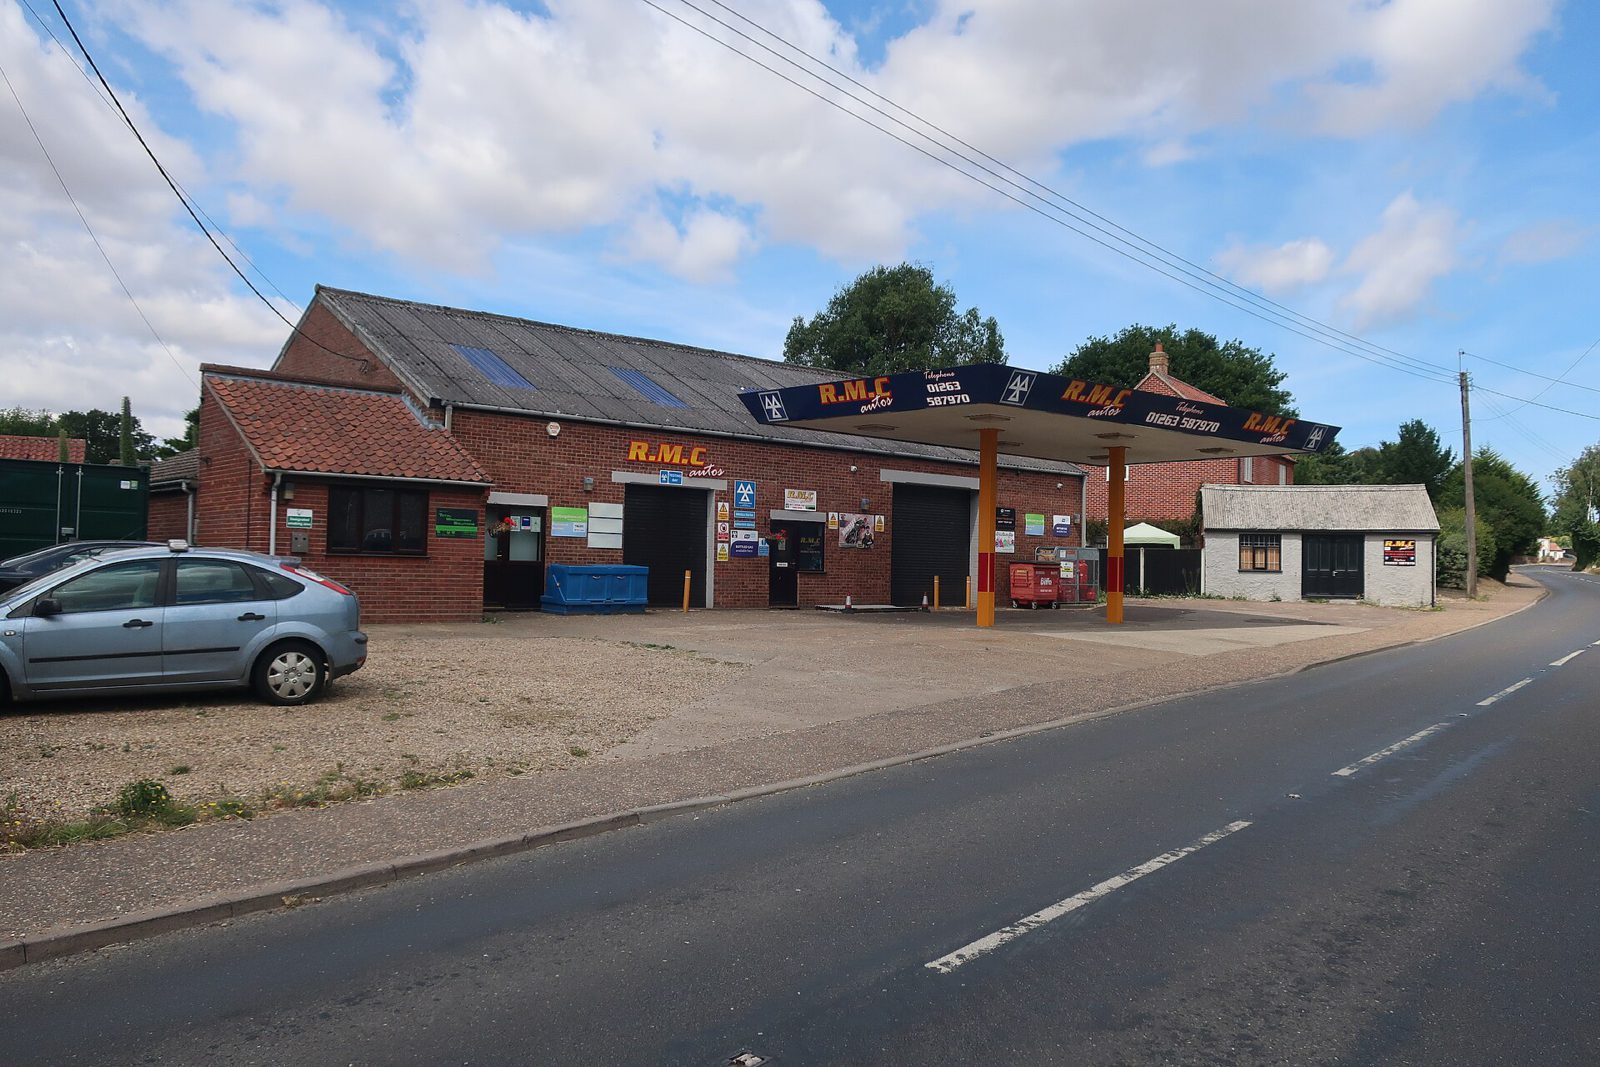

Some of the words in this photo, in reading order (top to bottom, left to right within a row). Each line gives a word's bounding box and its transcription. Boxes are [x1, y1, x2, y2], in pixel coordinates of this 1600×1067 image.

[923, 370, 955, 381] Telephone
[818, 376, 892, 404] R.M.C
[926, 381, 961, 393] 01263
[1061, 380, 1132, 408] R.M.C
[860, 395, 893, 414] autos
[926, 393, 970, 406] 587970
[1087, 404, 1122, 417] autos
[1175, 401, 1204, 415] Telephone
[1145, 411, 1180, 427] 01263
[1179, 416, 1220, 433] 587970
[1243, 412, 1296, 435] R.M.C
[1259, 431, 1286, 444] autos
[627, 441, 707, 466] R.M.C
[688, 463, 725, 478] autos
